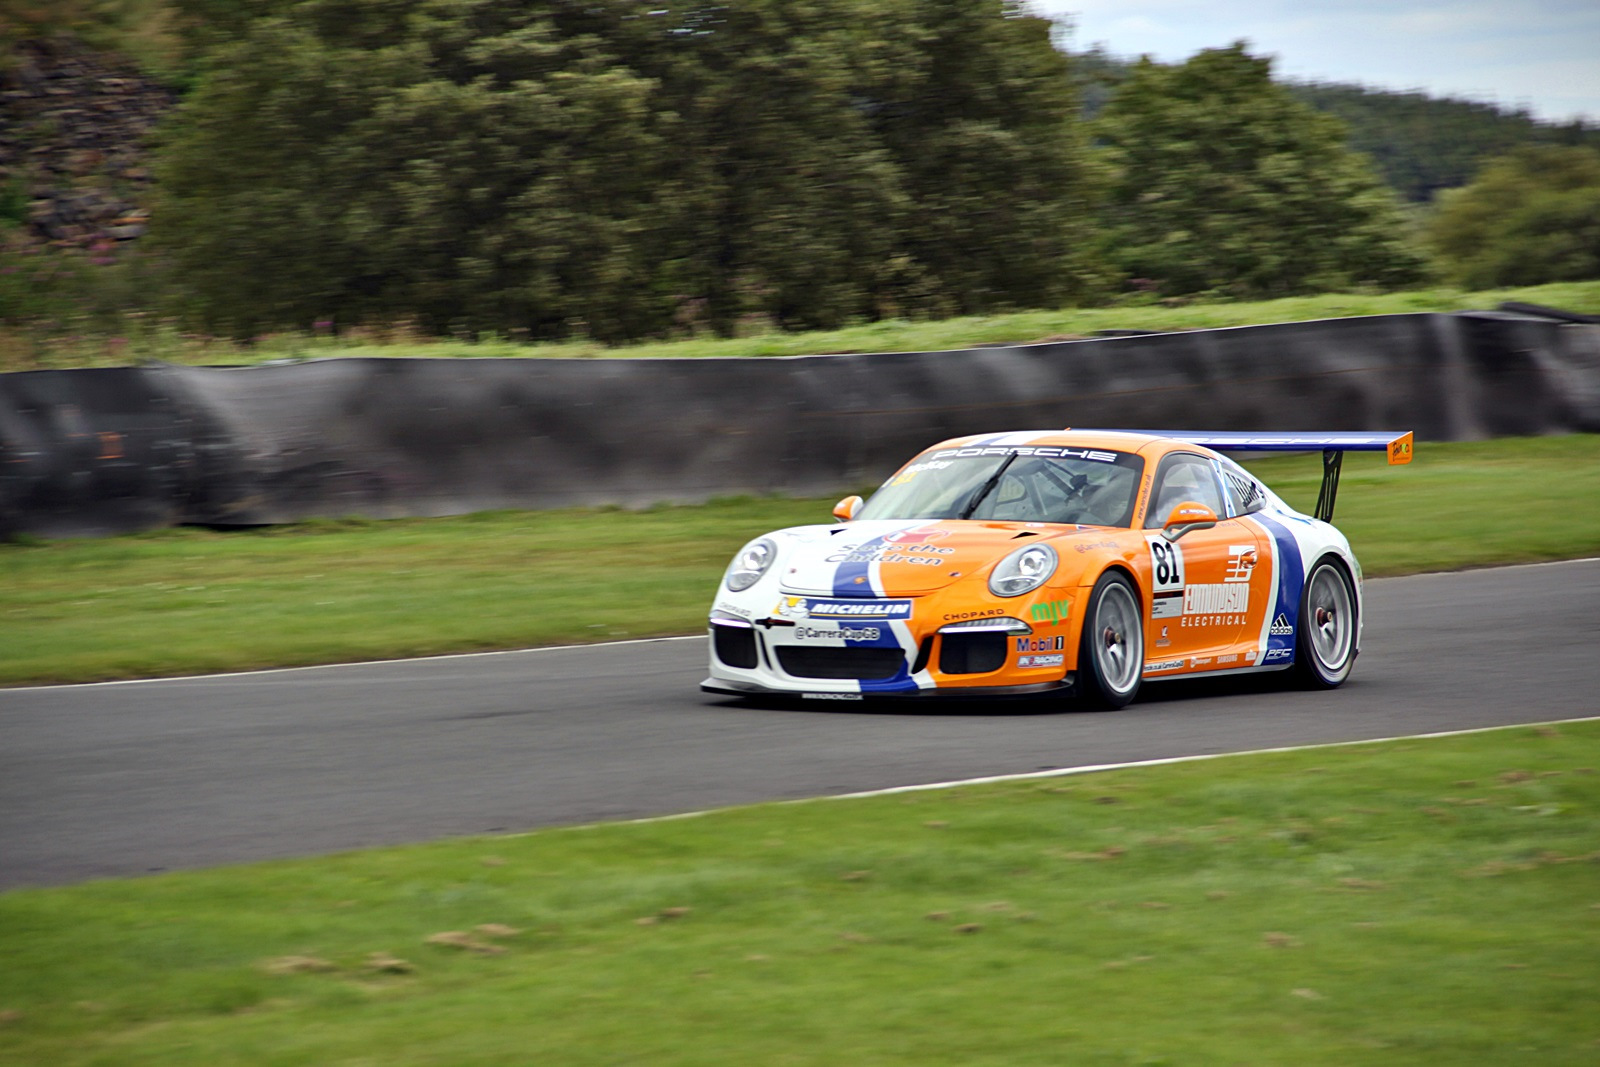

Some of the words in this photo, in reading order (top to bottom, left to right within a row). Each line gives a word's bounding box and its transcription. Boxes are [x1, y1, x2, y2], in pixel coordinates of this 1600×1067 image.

[931, 447, 1117, 462] PORSCHE
[837, 543, 902, 553] Save
[908, 544, 954, 554] the
[824, 553, 942, 565] Children
[1151, 541, 1180, 585] 81
[810, 603, 910, 614] MICHELIN
[943, 608, 1005, 621] CHOPARD
[1180, 615, 1247, 627] ELECTRICAL
[795, 627, 880, 641] @CarreraCupGB
[1270, 626, 1293, 634] adidas
[1017, 637, 1053, 652] Mobil
[1056, 636, 1063, 650] 1
[1267, 648, 1292, 657] PFC
